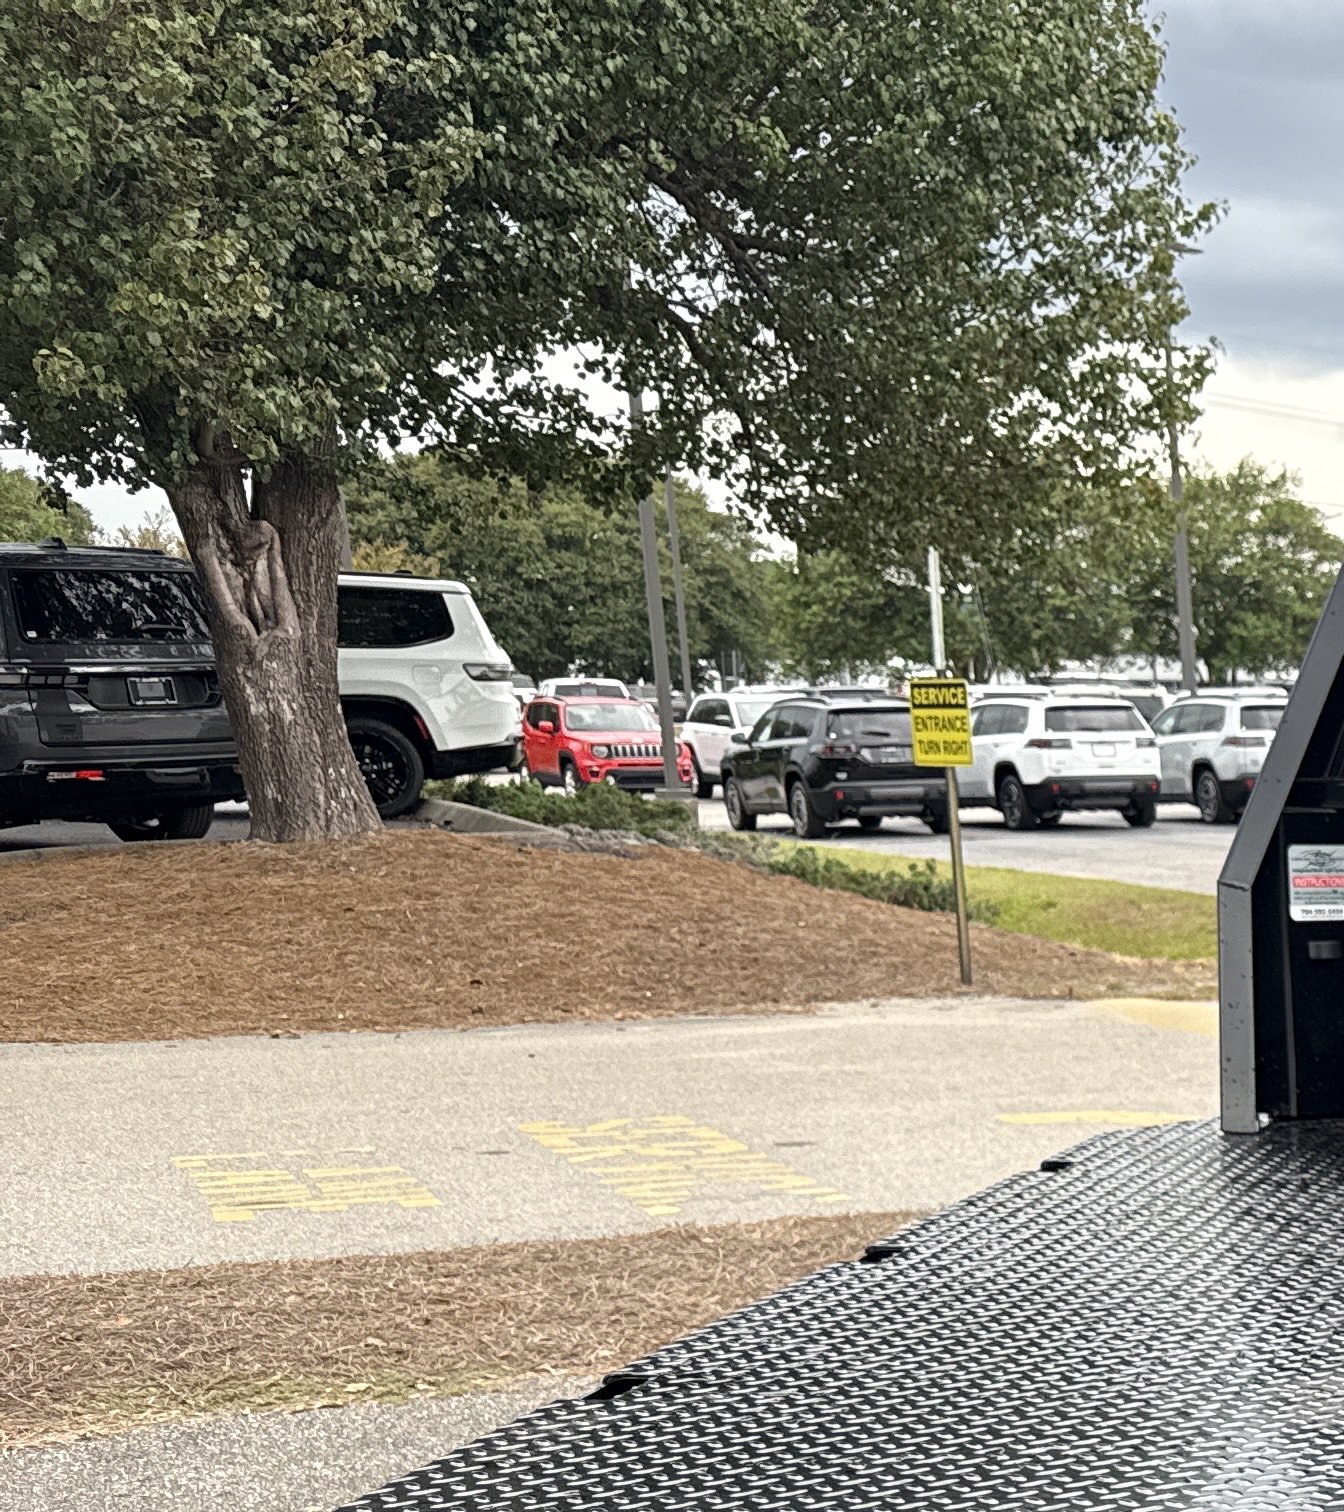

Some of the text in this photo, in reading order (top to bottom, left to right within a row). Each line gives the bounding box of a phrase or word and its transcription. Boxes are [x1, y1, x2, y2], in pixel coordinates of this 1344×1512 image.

[913, 686, 965, 705] SERVICE
[914, 715, 968, 732] ENTRANCE
[918, 740, 968, 755] TURN RIGHT
